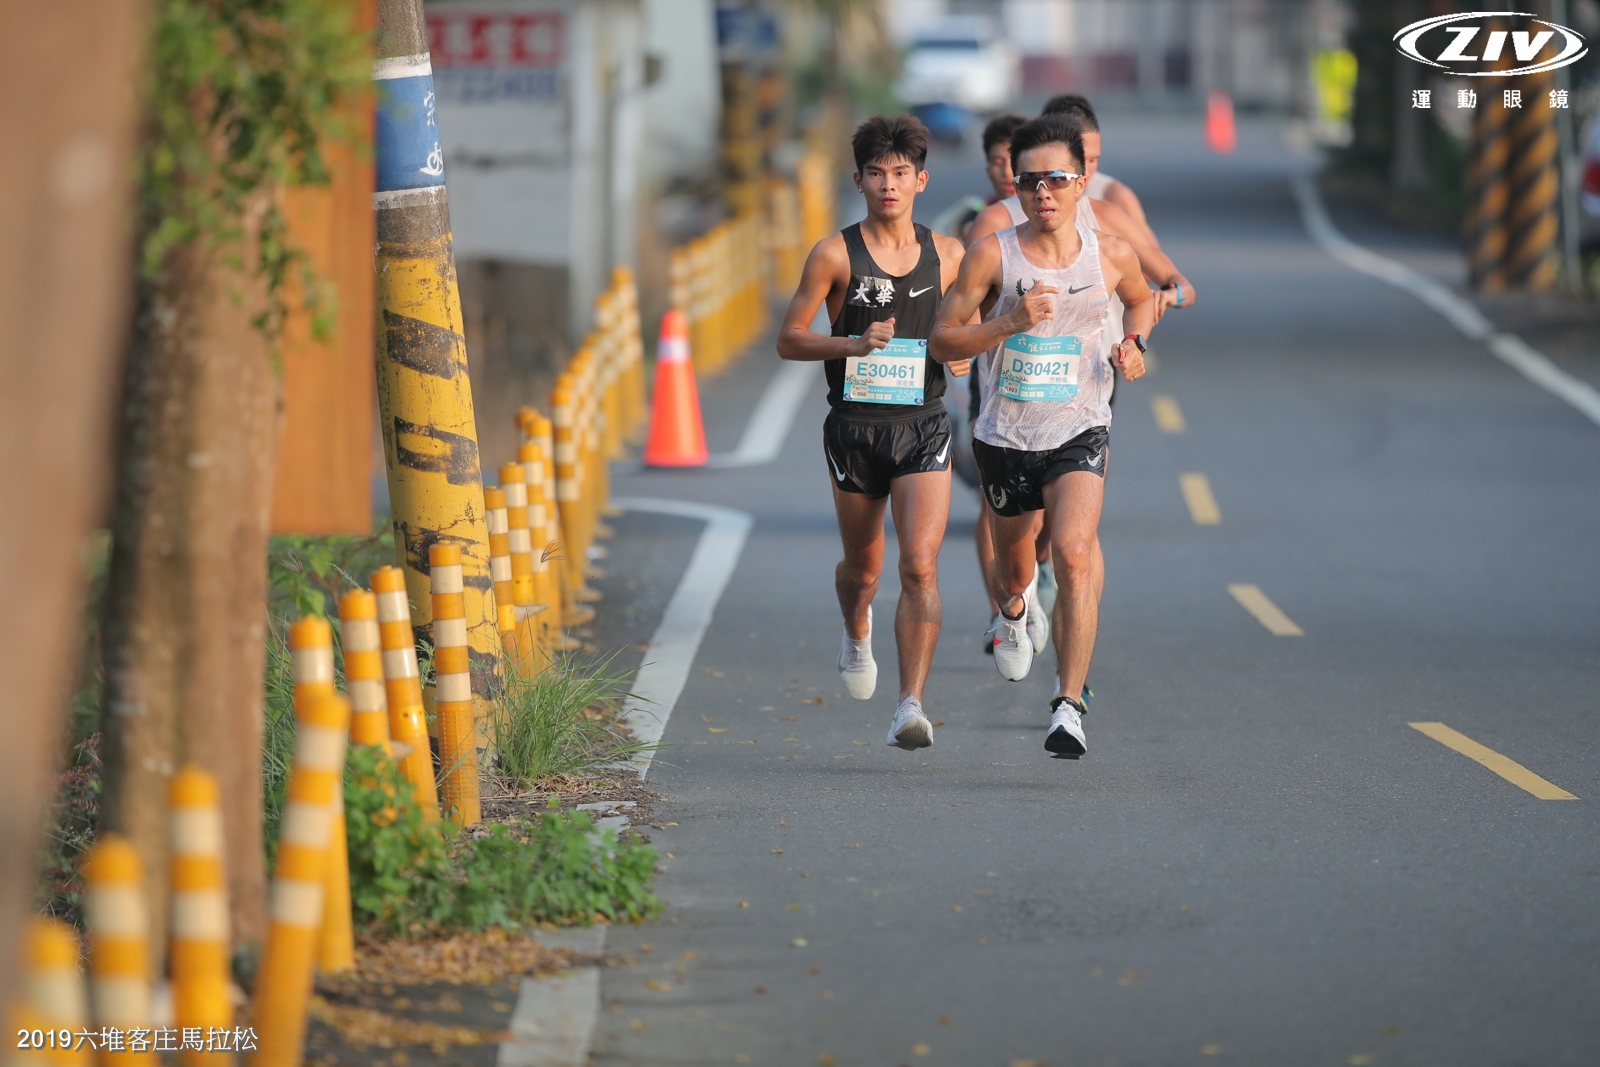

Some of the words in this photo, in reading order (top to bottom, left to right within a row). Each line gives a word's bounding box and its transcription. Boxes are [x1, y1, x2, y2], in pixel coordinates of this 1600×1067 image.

[852, 282, 894, 307] 大華
[856, 361, 916, 379] E30461
[1011, 358, 1070, 376] D30421
[896, 389, 918, 399] 25K
[1048, 386, 1071, 395] 25K
